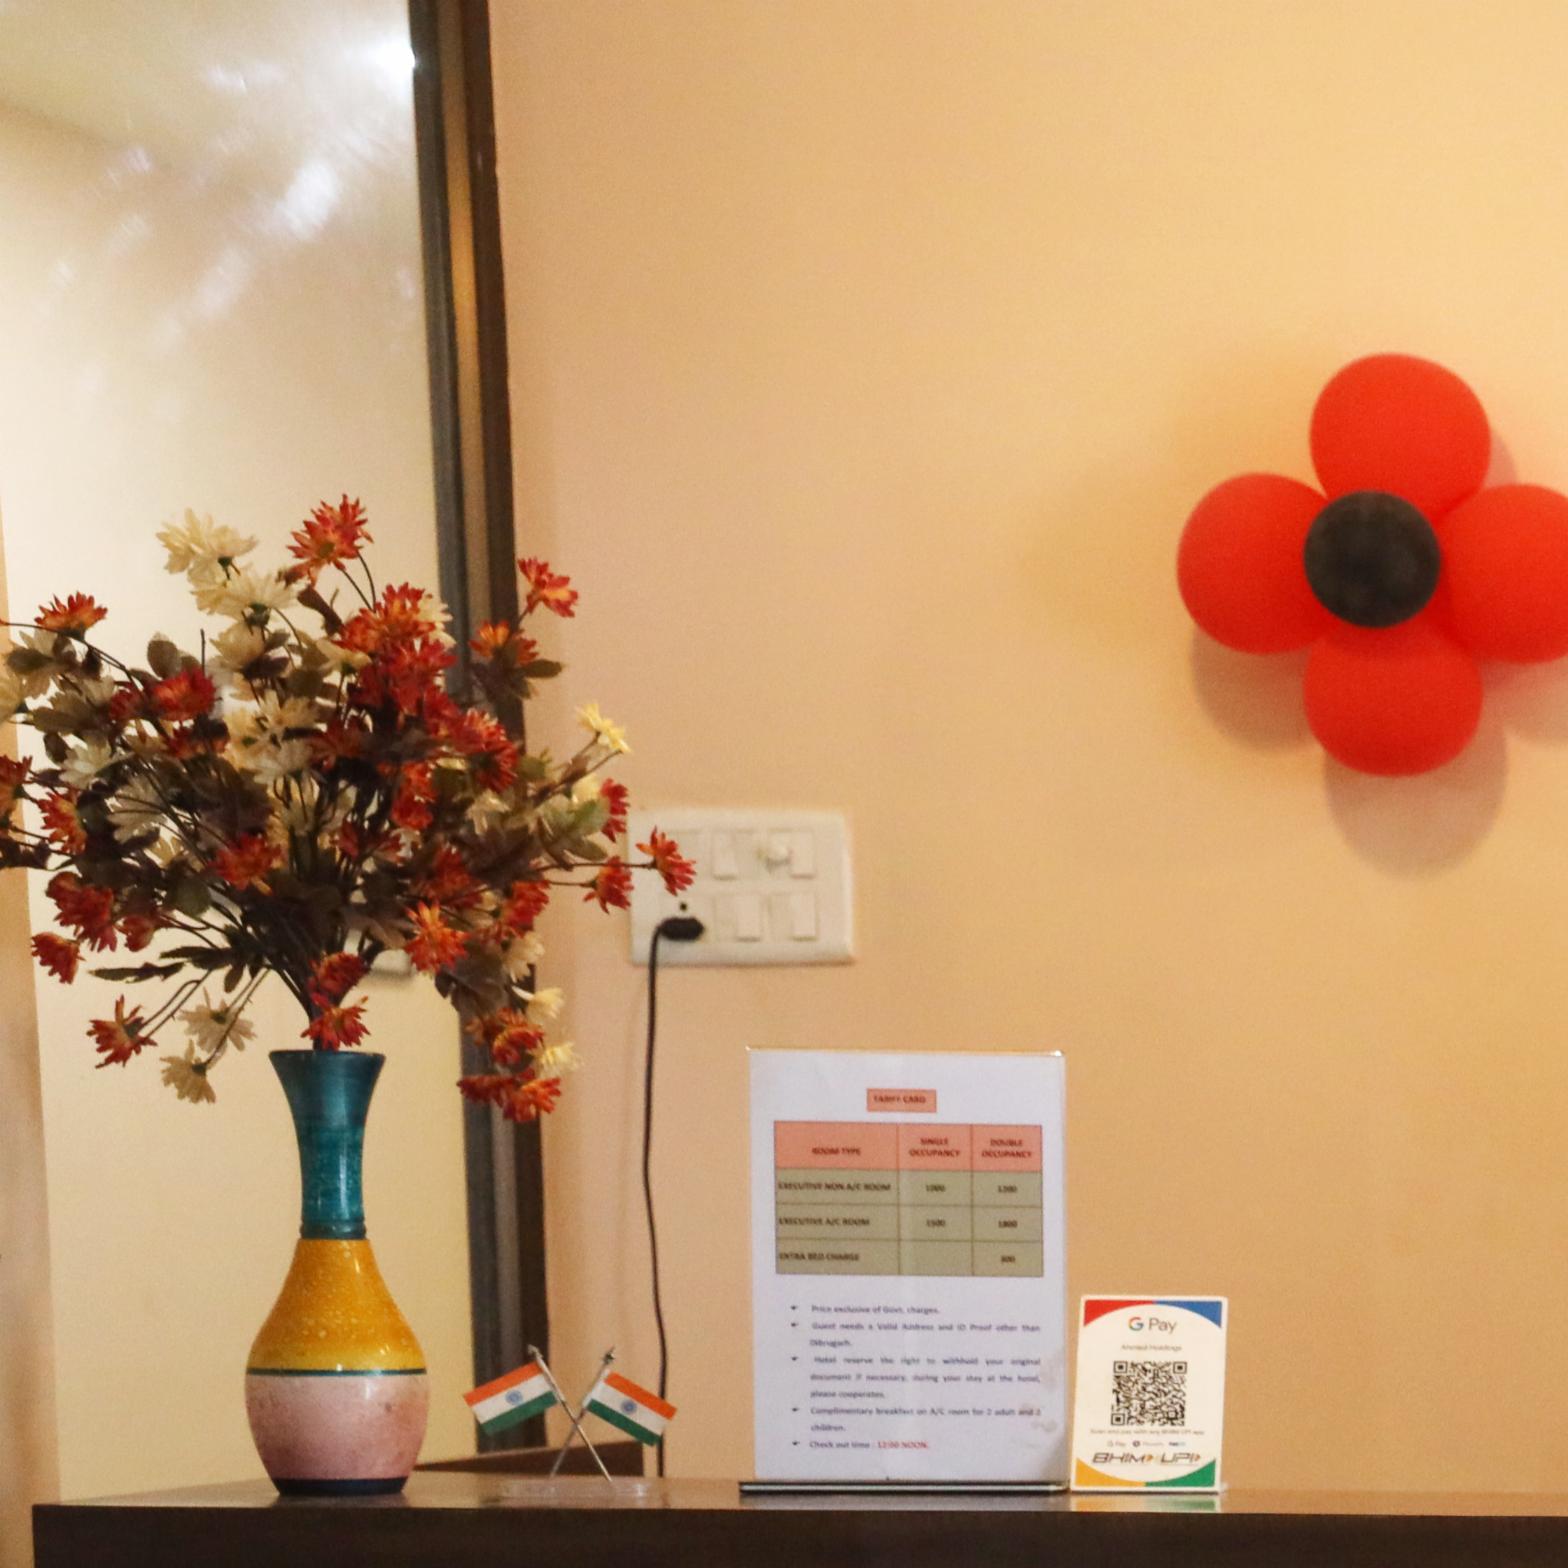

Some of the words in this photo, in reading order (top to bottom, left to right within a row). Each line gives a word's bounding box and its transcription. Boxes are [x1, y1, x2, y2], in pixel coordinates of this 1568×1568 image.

[902, 1095, 927, 1104] CARD
[920, 1137, 949, 1146] SINGLE
[990, 1138, 1024, 1147] DOUBLE
[811, 1147, 840, 1156] ROOM
[841, 1147, 862, 1156] TYPE
[908, 1149, 961, 1158] OCCUPANCY
[981, 1150, 1032, 1159] OCCUPANCY
[777, 1182, 823, 1191] EXECUTIVE
[824, 1182, 845, 1191] NON
[846, 1182, 862, 1191] A/C
[863, 1183, 892, 1191] ROOM
[778, 1217, 823, 1226] EXECUTIVE
[824, 1217, 842, 1226] A/C
[842, 1217, 871, 1227] ROOM
[778, 1252, 806, 1261] EXTRA
[807, 1253, 825, 1262] BED
[826, 1253, 860, 1262] CHARGE
[811, 1305, 832, 1313] Price
[833, 1305, 871, 1314] exclusive
[872, 1305, 881, 1313] of
[907, 1306, 939, 1316] charges.
[811, 1322, 836, 1330] Guest
[839, 1322, 864, 1330] needs
[902, 1322, 934, 1331] Address
[938, 1323, 954, 1331] and
[957, 1323, 966, 1331] ID
[969, 1323, 992, 1331] Proof
[995, 1323, 1018, 1332] other
[1021, 1324, 1040, 1332] than
[1128, 1317, 1144, 1331] G
[1148, 1317, 1177, 1333] Pay
[814, 1356, 837, 1364] Hotel
[880, 1356, 894, 1364] the
[900, 1356, 920, 1366] right
[942, 1356, 979, 1365] withhold
[985, 1358, 1003, 1366] your
[1010, 1357, 1041, 1367] original
[810, 1373, 851, 1382] document
[912, 1374, 938, 1384] during
[942, 1375, 960, 1383] your
[965, 1375, 982, 1384] stay
[999, 1374, 1013, 1382] the
[1017, 1375, 1041, 1384] hotel,
[810, 1391, 836, 1399] please
[810, 1407, 874, 1417] Complimentary
[875, 1407, 914, 1416] breakfast
[930, 1408, 945, 1416] A/C
[972, 1408, 984, 1416] for
[994, 1408, 1016, 1416] adult
[1017, 1408, 1034, 1416] and
[810, 1423, 846, 1432] children.
[809, 1440, 834, 1449] Check
[835, 1440, 849, 1449] out
[851, 1440, 871, 1449] time
[1092, 1452, 1147, 1464] BHIM
[1160, 1452, 1197, 1464] UPI
